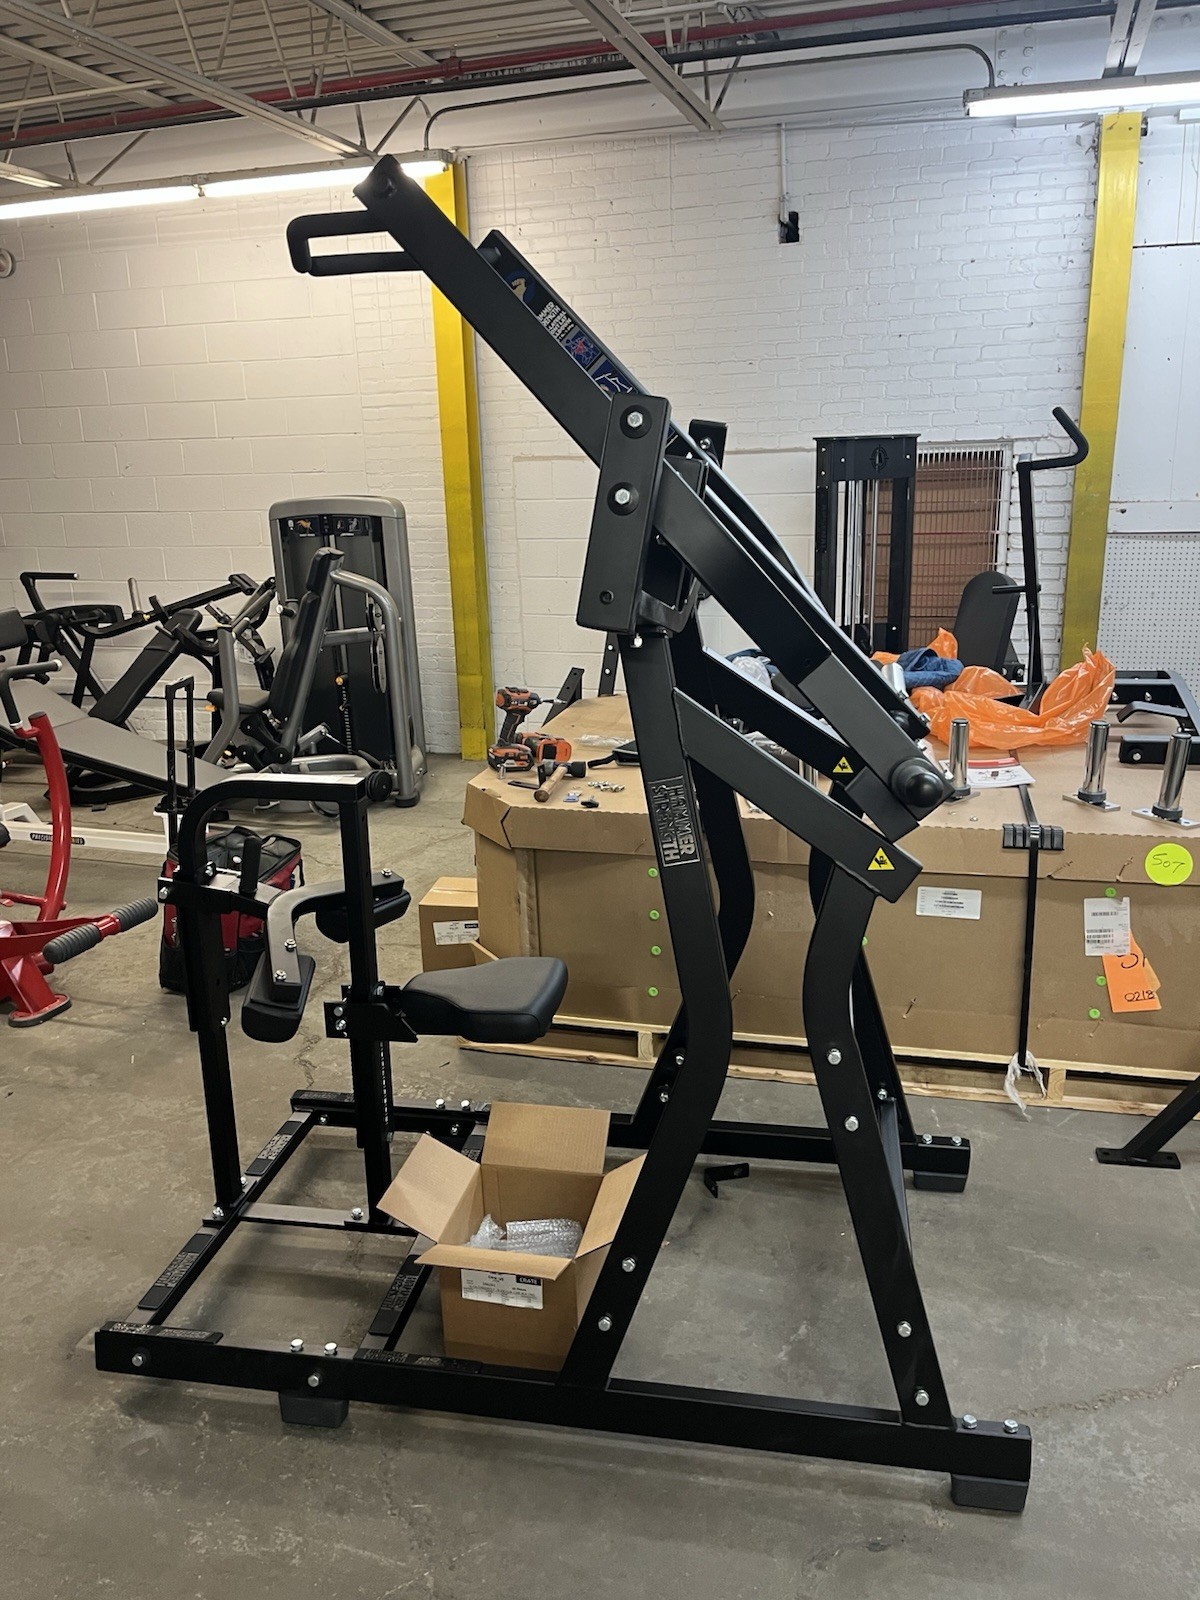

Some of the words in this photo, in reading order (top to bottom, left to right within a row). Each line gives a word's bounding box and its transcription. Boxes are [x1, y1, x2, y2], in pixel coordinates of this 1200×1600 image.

[651, 785, 681, 861] STRENGTH
[667, 785, 695, 855] HAMMER
[1152, 852, 1186, 873] 507
[1124, 990, 1156, 1001] 0218
